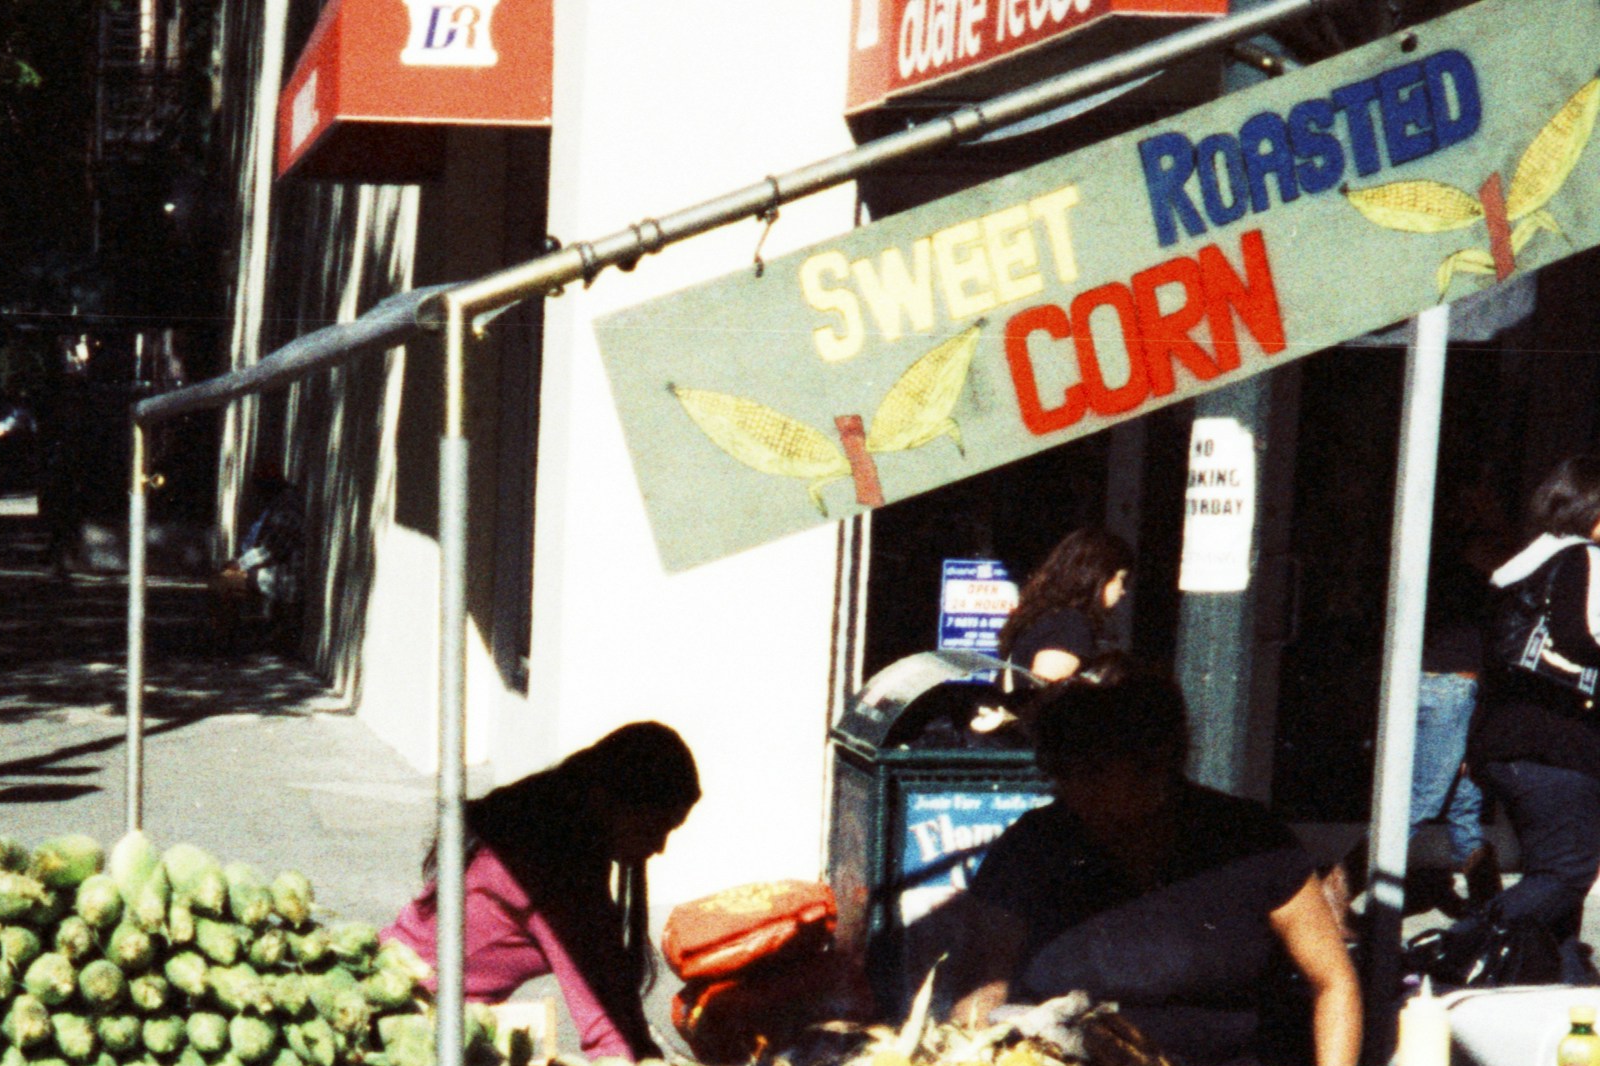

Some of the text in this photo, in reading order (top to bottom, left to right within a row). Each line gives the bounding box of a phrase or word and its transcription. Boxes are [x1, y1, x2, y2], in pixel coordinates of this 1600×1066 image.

[799, 50, 1482, 363] SWEET ROASTED
[1005, 230, 1286, 436] CORN
[967, 584, 999, 595] OPEN
